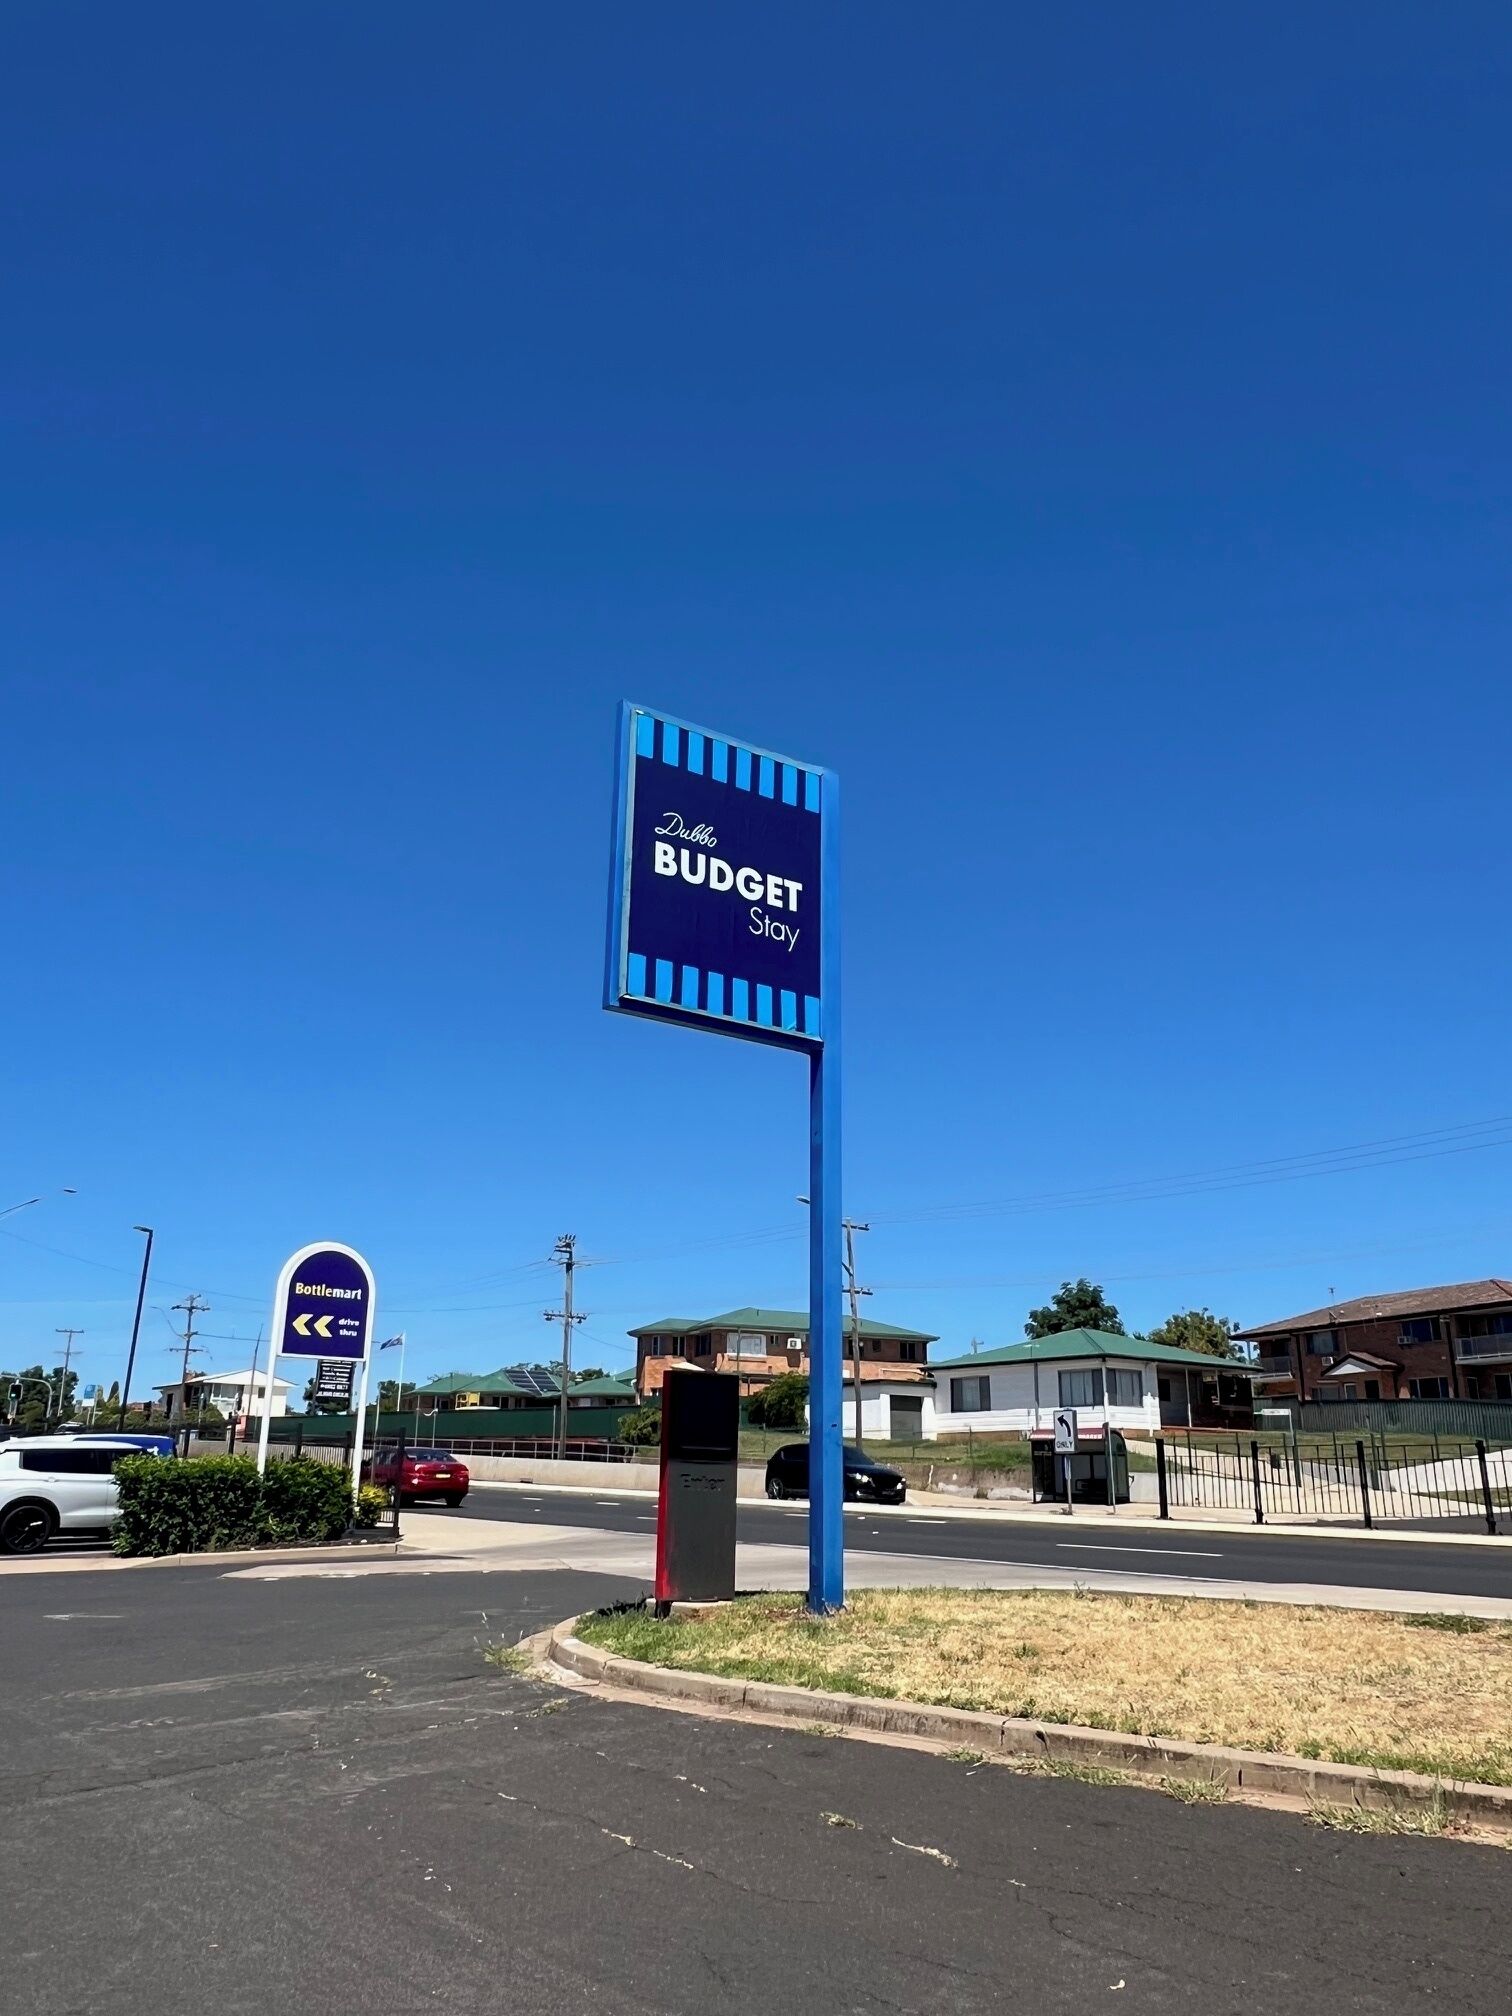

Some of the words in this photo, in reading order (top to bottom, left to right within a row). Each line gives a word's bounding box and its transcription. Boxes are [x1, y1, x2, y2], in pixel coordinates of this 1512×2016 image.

[654, 812, 718, 848] Dubbo
[654, 840, 803, 912] BUDGET
[749, 906, 800, 952] Stay
[295, 1282, 362, 1300] Bottlemart
[338, 1318, 360, 1326] drive
[339, 1328, 358, 1337] thru
[1056, 1441, 1073, 1449] ONLY
